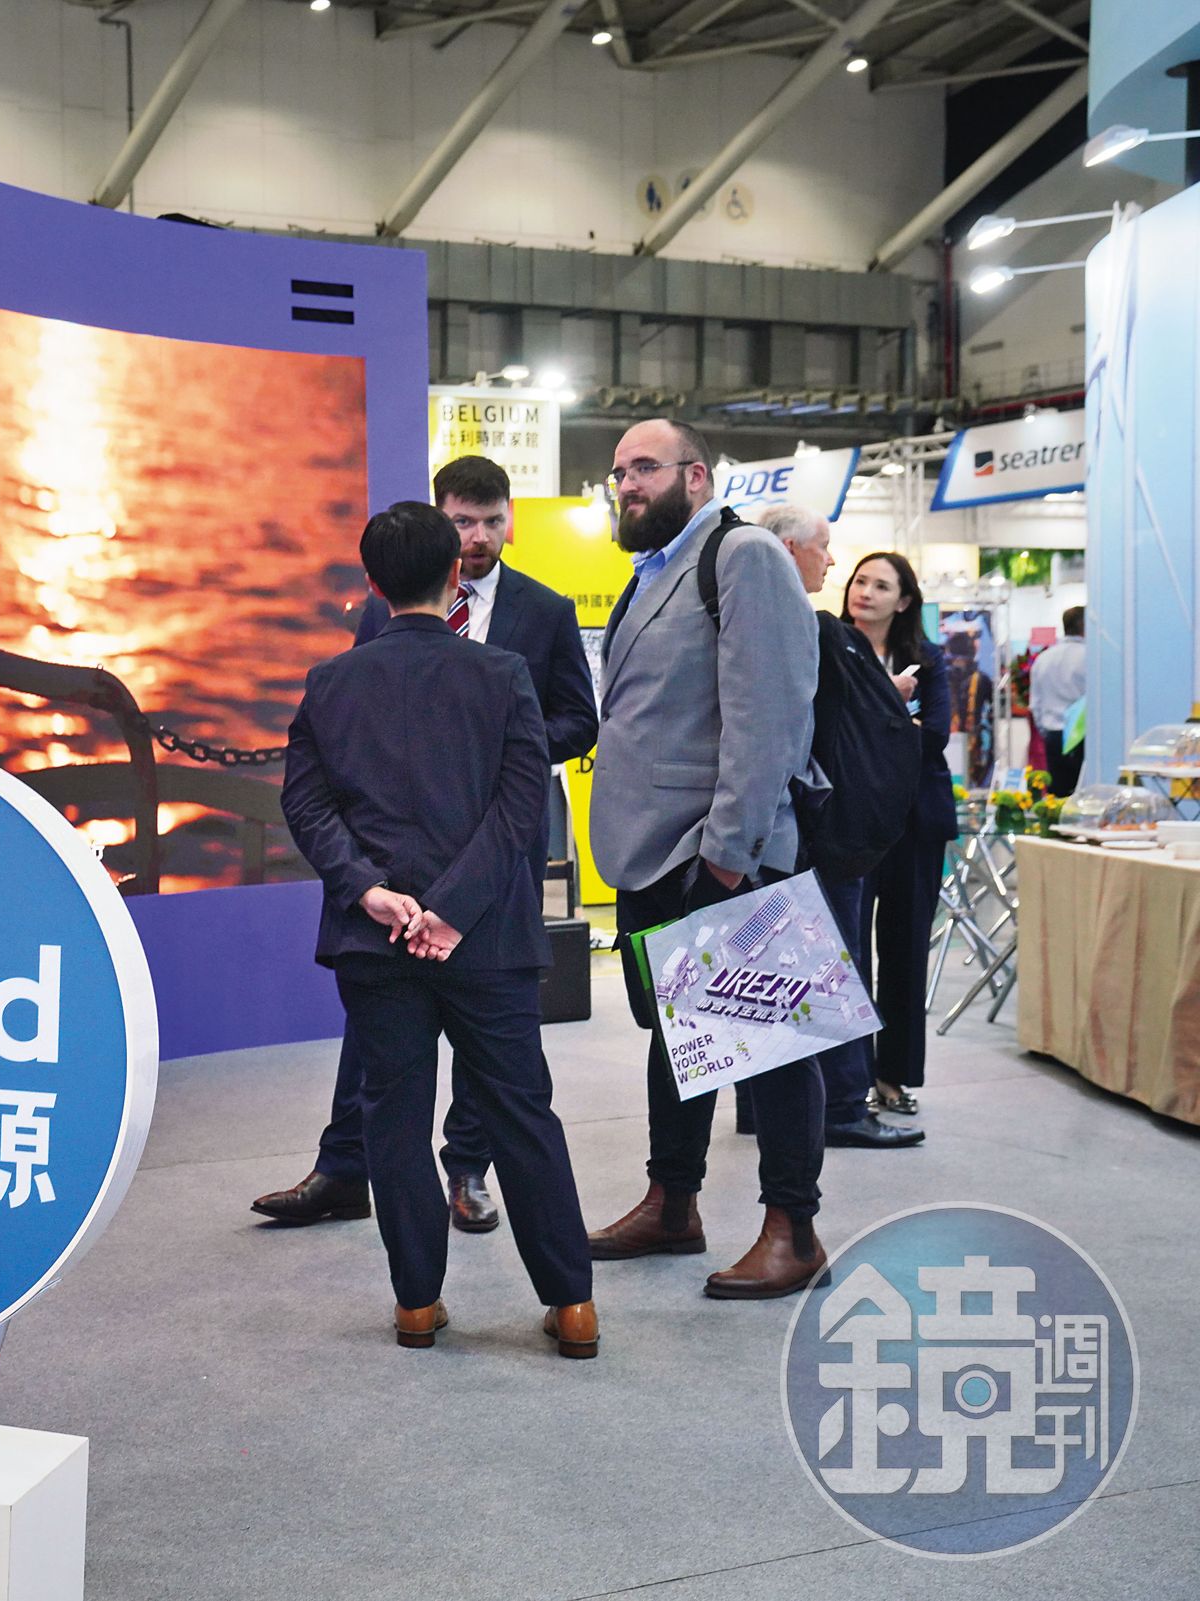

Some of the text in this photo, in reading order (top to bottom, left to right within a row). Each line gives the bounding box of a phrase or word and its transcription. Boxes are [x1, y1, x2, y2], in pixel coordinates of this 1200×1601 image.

[443, 404, 539, 423] BELGIUM
[724, 466, 795, 499] PDE
[672, 1034, 714, 1059] POWER
[674, 1051, 708, 1072] YOUR
